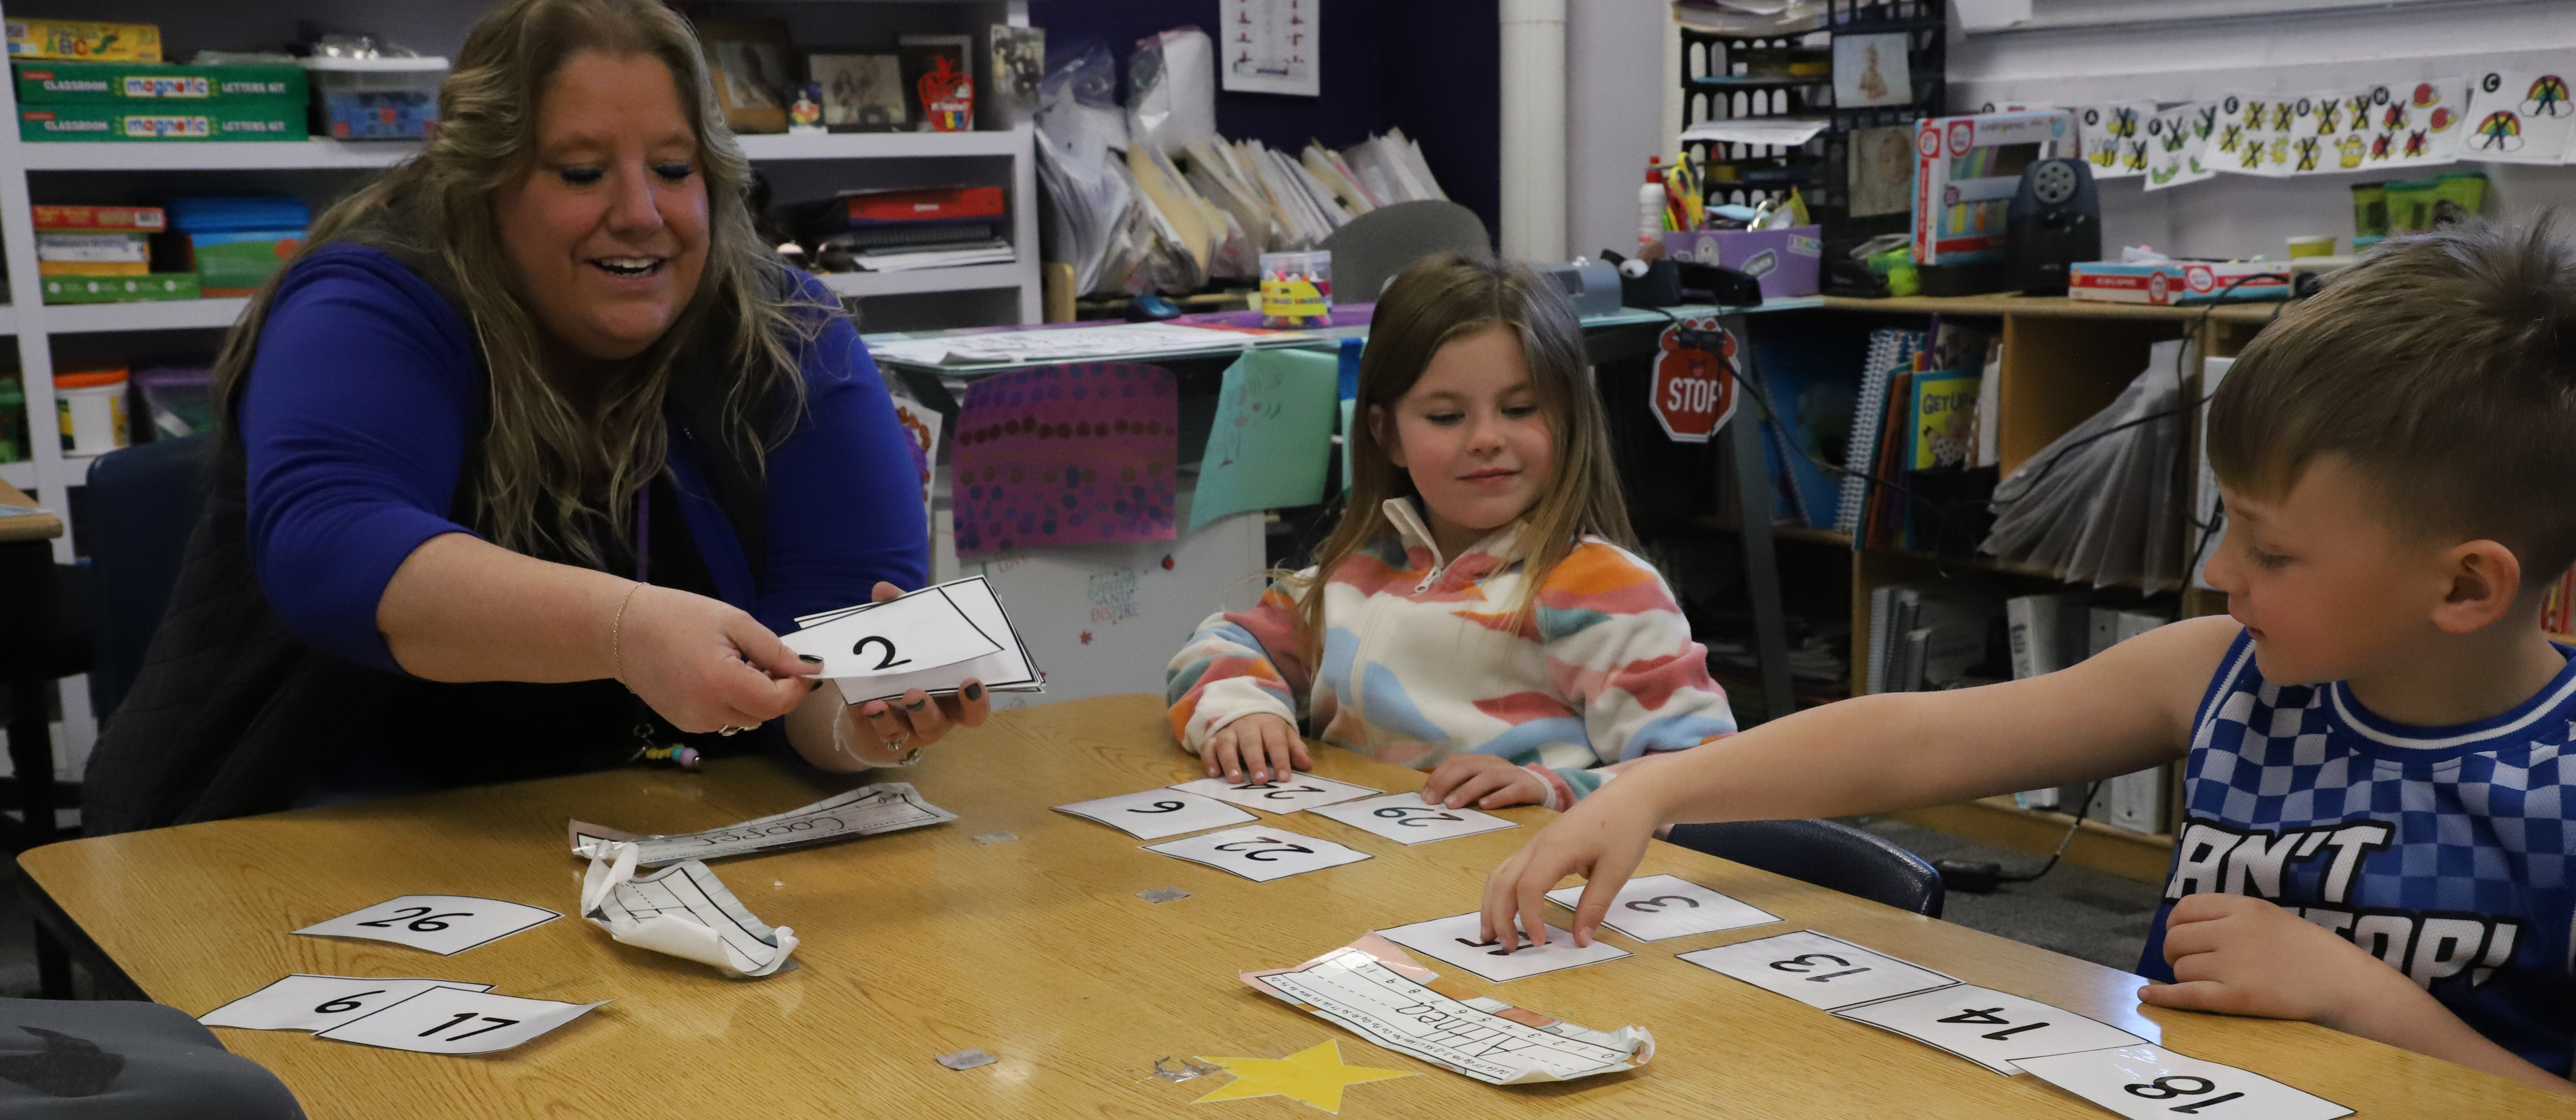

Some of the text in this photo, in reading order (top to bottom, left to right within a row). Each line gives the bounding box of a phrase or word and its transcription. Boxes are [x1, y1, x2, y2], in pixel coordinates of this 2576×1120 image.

[43, 77, 285, 95] CLASSROOM magnetic LETTERS KIT
[44, 116, 285, 135] CLASSROOM magnetic LETTERS KIT
[1667, 377, 1722, 413] STOP
[1923, 393, 1949, 414] GET
[853, 635, 912, 670] 2
[1214, 836, 1314, 862] 22
[2166, 822, 2388, 903] AN'T
[1625, 895, 1699, 913] 3
[357, 907, 474, 932] 26
[2283, 907, 2518, 990] TOP!
[1769, 952, 1872, 983] 13
[314, 990, 386, 1013] 6
[417, 1012, 520, 1041] 17
[1936, 1007, 2050, 1041] 14
[2124, 1075, 2245, 1115] 18
